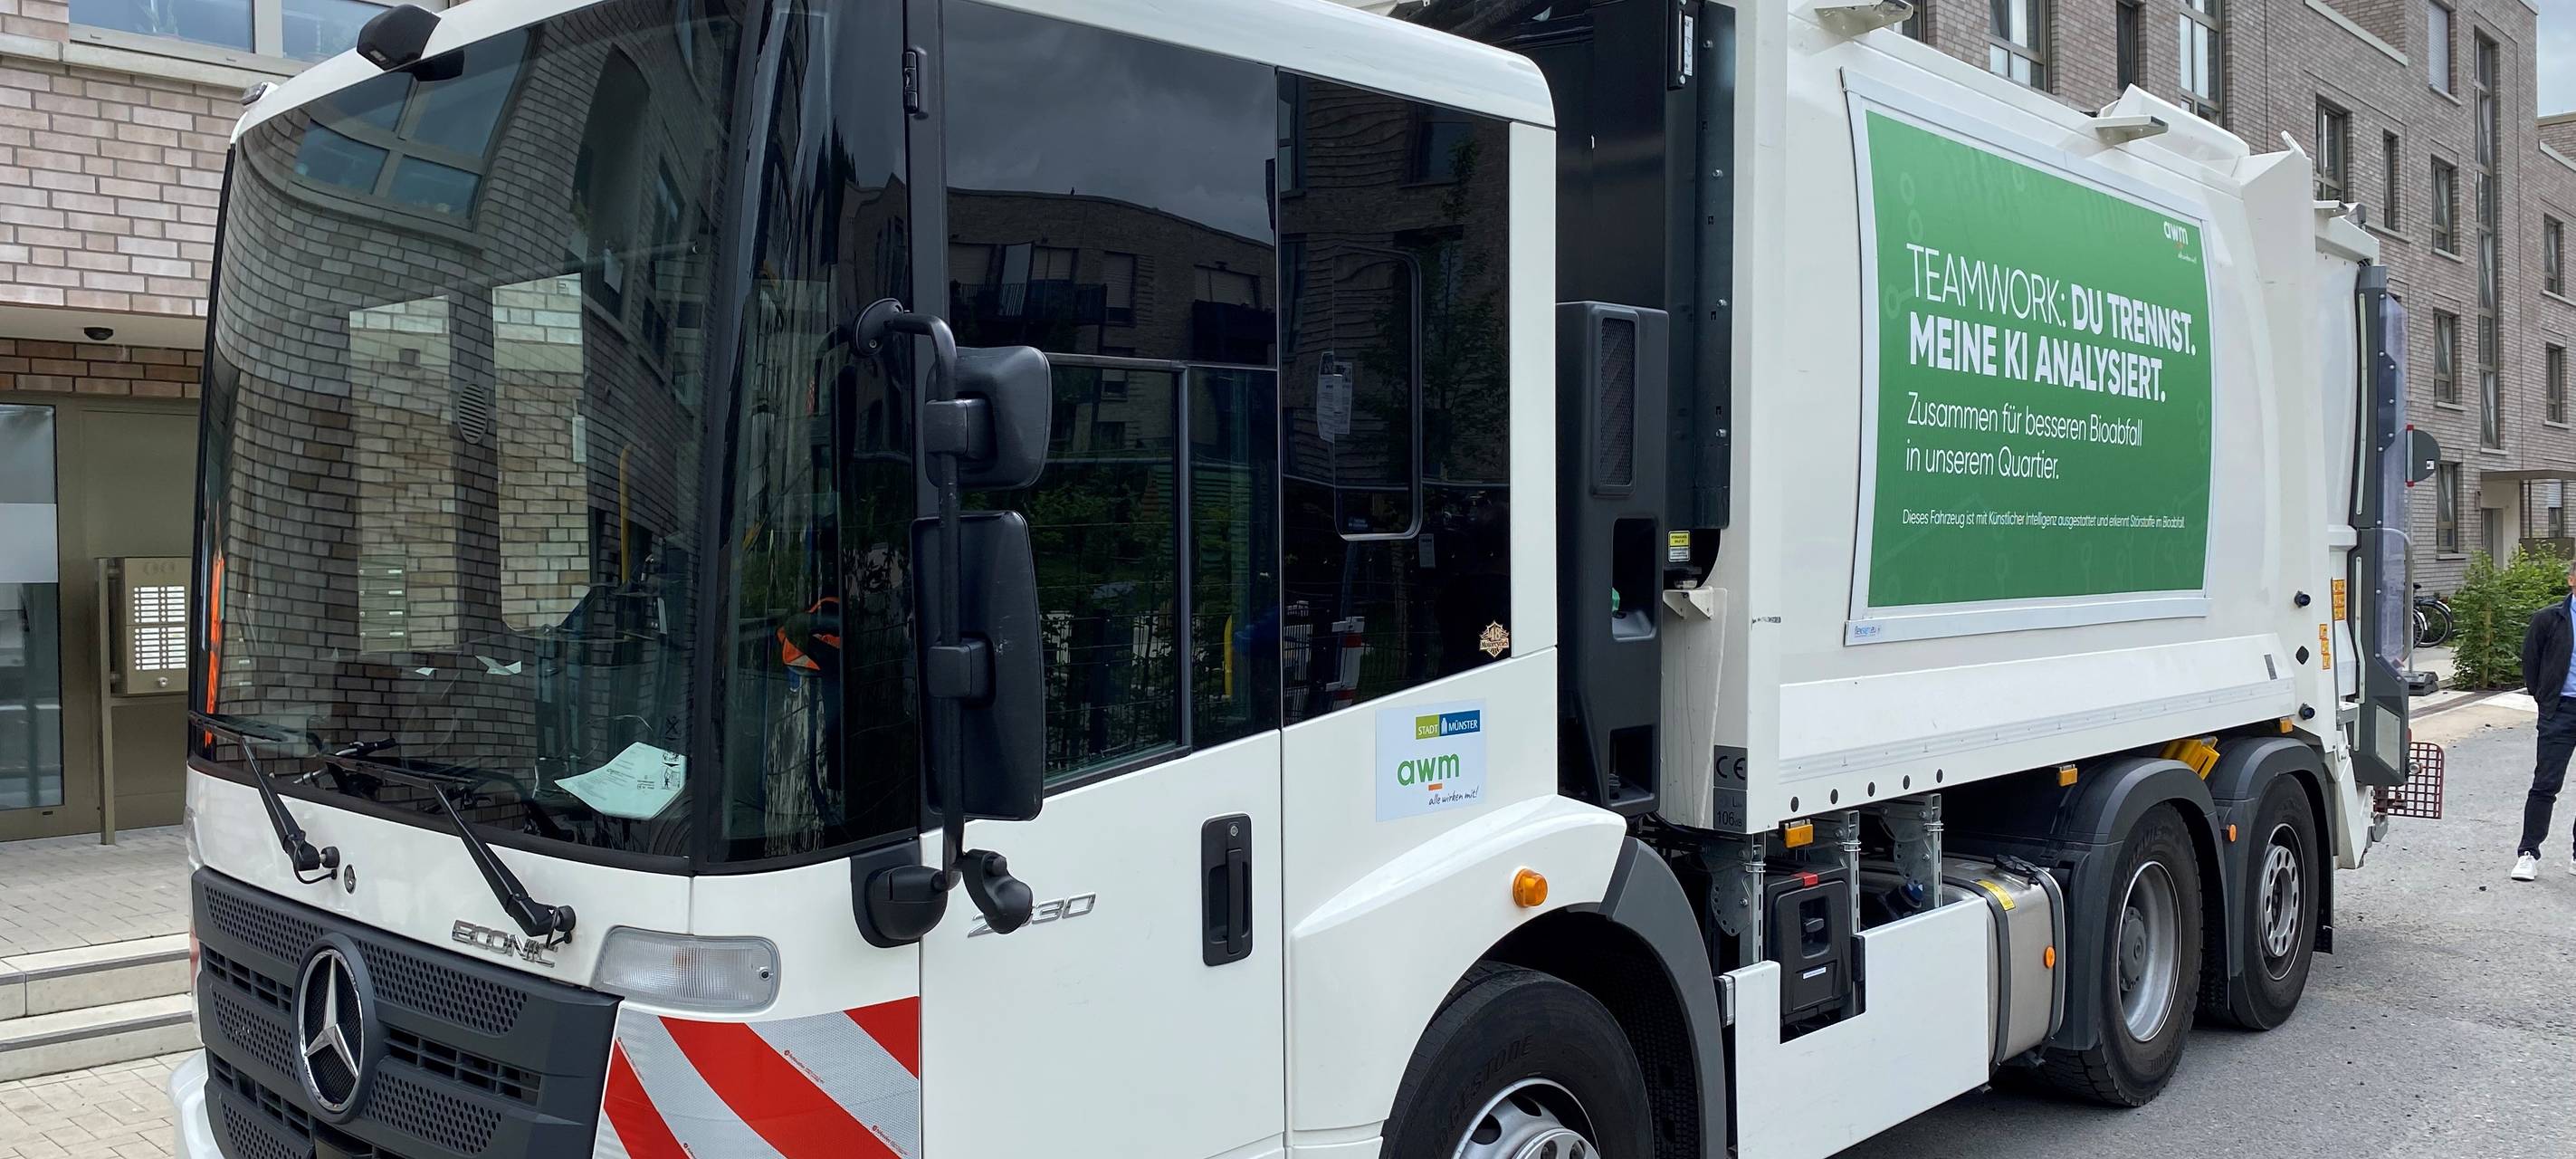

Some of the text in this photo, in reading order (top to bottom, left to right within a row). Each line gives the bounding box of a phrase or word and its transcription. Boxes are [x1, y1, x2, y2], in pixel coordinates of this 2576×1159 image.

[2164, 221, 2188, 245] awm
[1906, 243, 2196, 355] TEAMWORK: DU TRENNST.
[1911, 311, 2165, 402] MEINE KI ANALYSIERT.
[1908, 392, 2142, 446] Zusammen für besseren Bioabfall
[1906, 438, 2059, 480] in unserem Quartier.
[1903, 509, 1929, 524] Dieses
[1930, 509, 1965, 528] Fahrzeug
[1966, 511, 1975, 525] ist
[1976, 511, 1988, 525] mit
[1989, 511, 2026, 526] Künstlicher
[1418, 719, 1478, 735] STADT MÜNSTER
[1397, 753, 1460, 786] awm
[1428, 785, 1480, 805] alle wirken mit!
